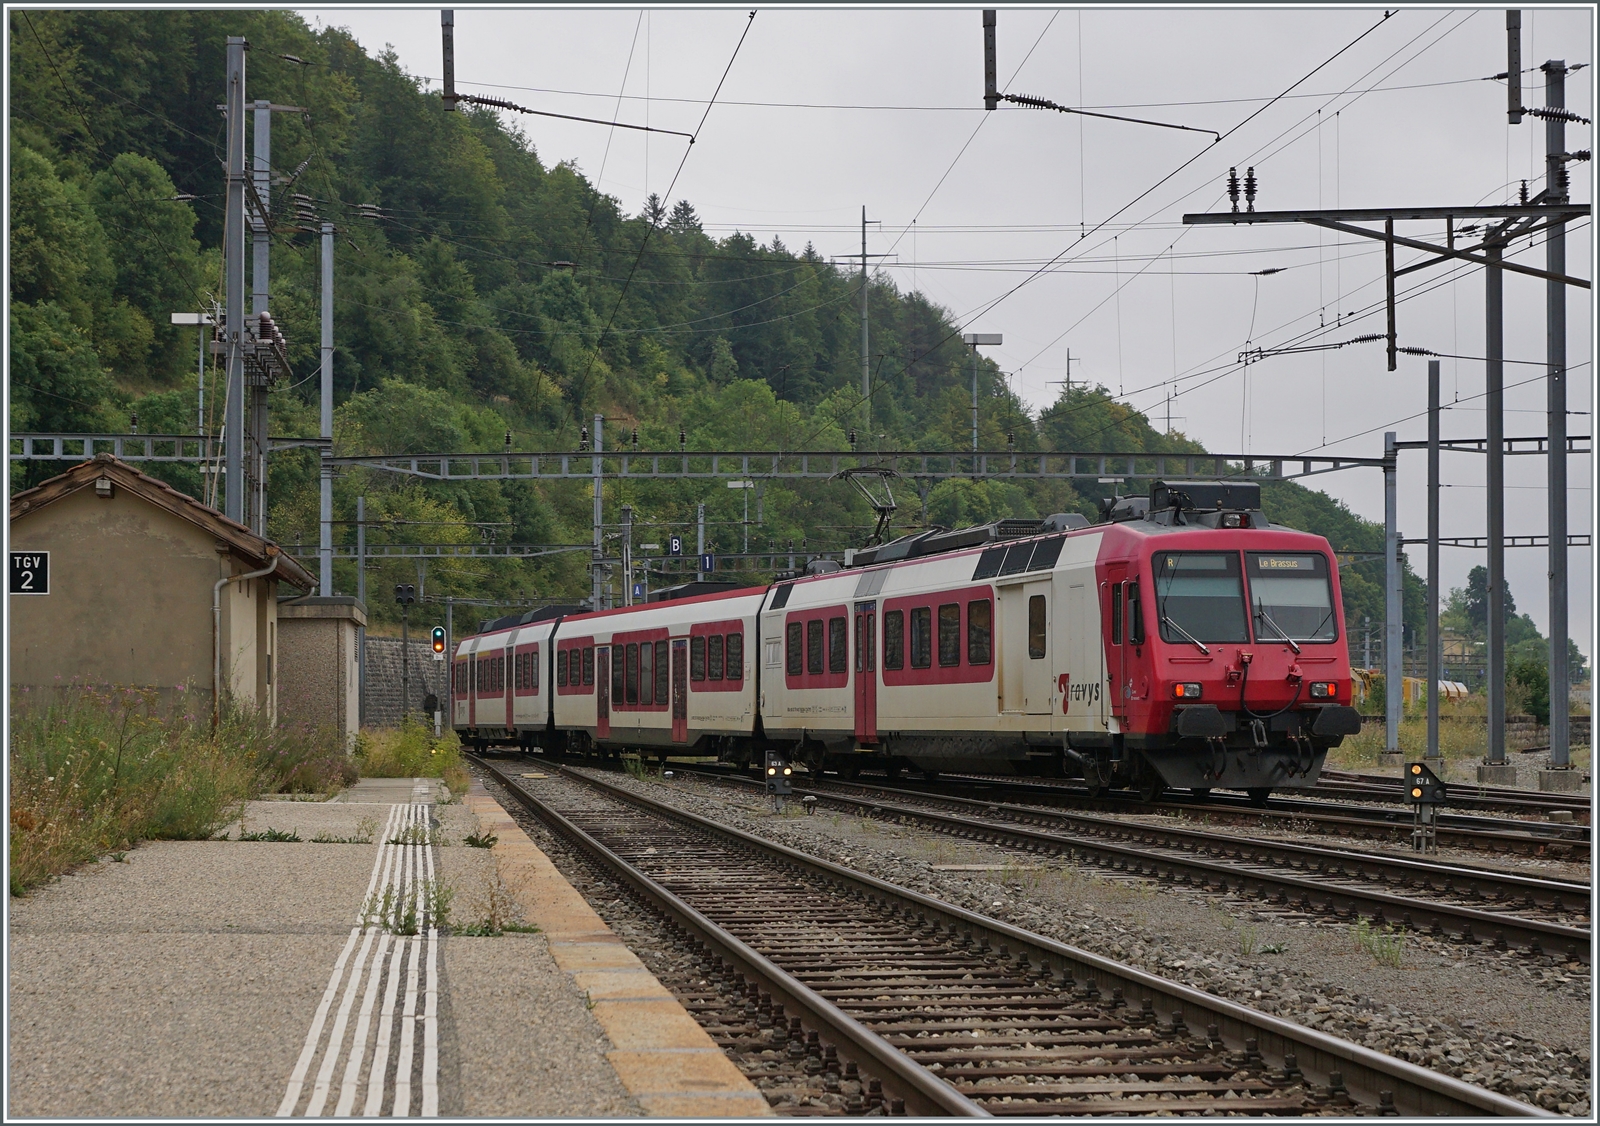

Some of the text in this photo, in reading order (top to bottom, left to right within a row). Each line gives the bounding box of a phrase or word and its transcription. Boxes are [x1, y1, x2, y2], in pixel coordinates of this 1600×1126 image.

[672, 539, 680, 551] B
[14, 556, 40, 568] TGV
[705, 556, 710, 569] 1
[1167, 558, 1174, 567] R
[1259, 558, 1298, 568] Le Brassus
[21, 570, 33, 589] 2
[634, 586, 640, 595] A
